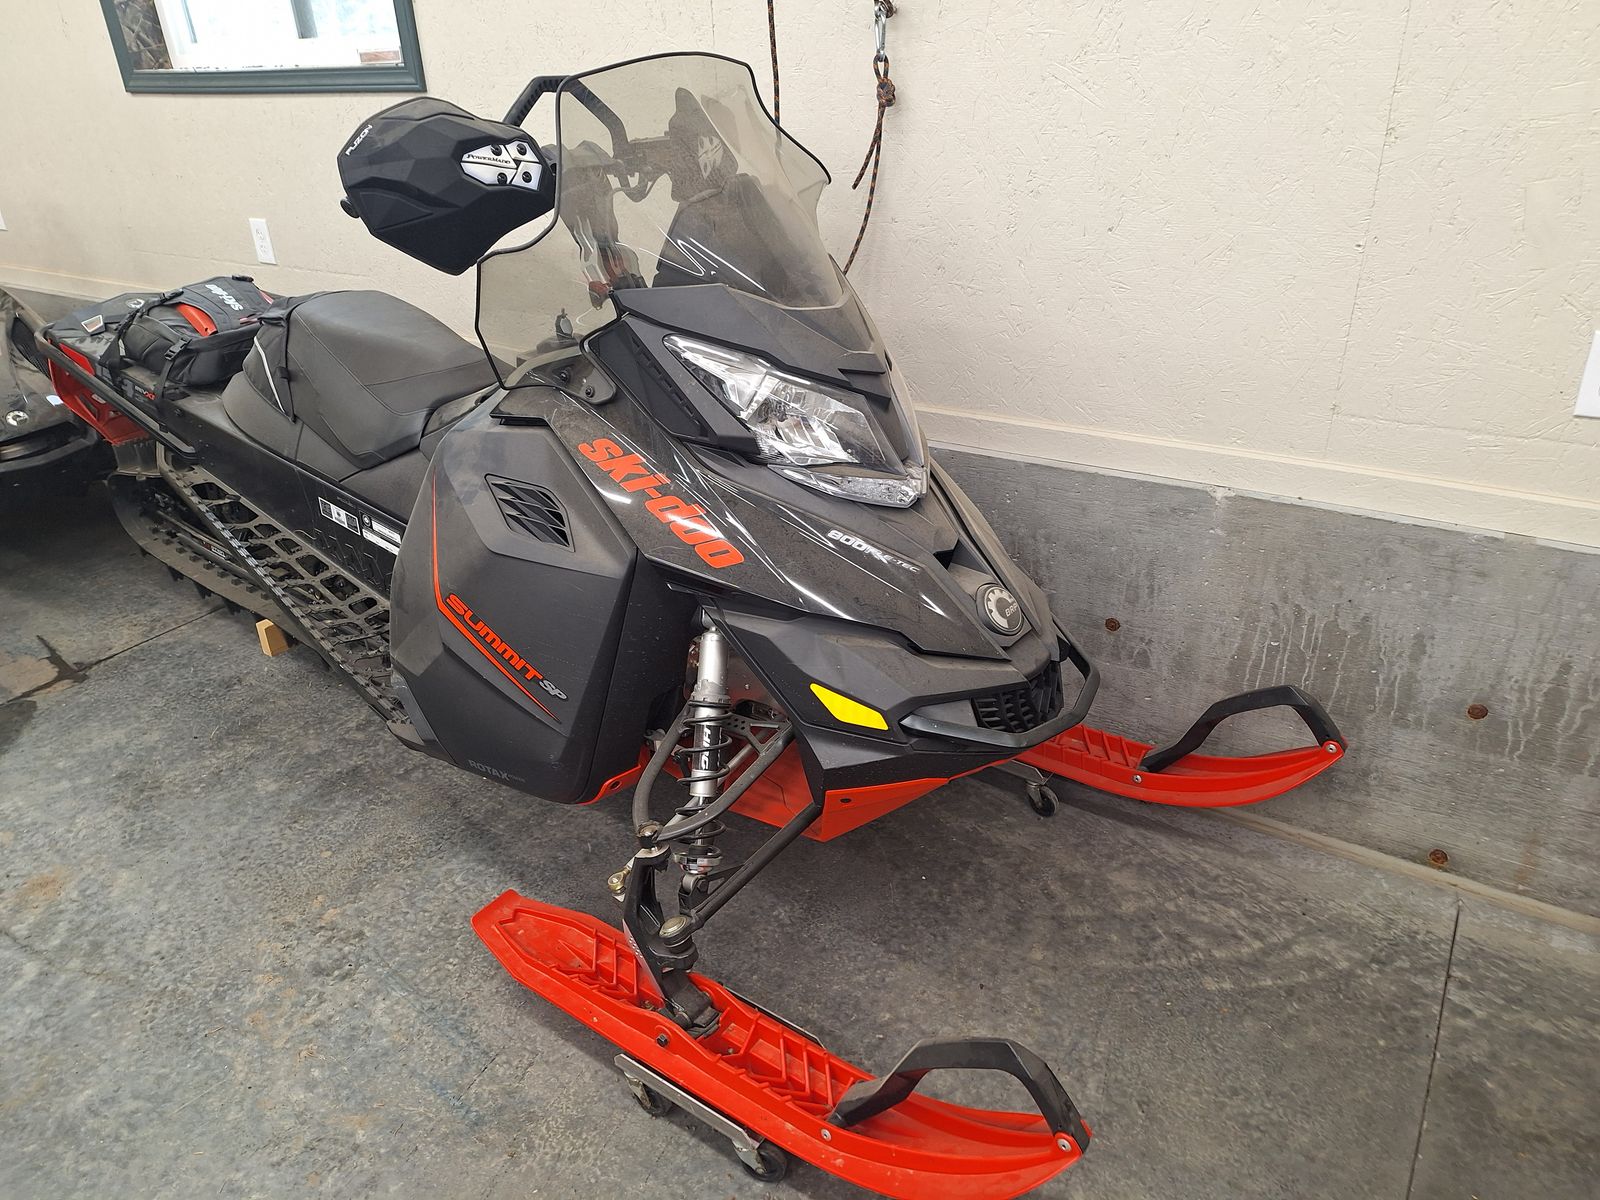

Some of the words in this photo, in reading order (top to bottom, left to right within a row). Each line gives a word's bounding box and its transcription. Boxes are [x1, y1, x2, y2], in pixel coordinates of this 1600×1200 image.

[445, 593, 544, 681] SUMMIT
[539, 679, 567, 700] SP
[468, 759, 511, 781] ROTAX
